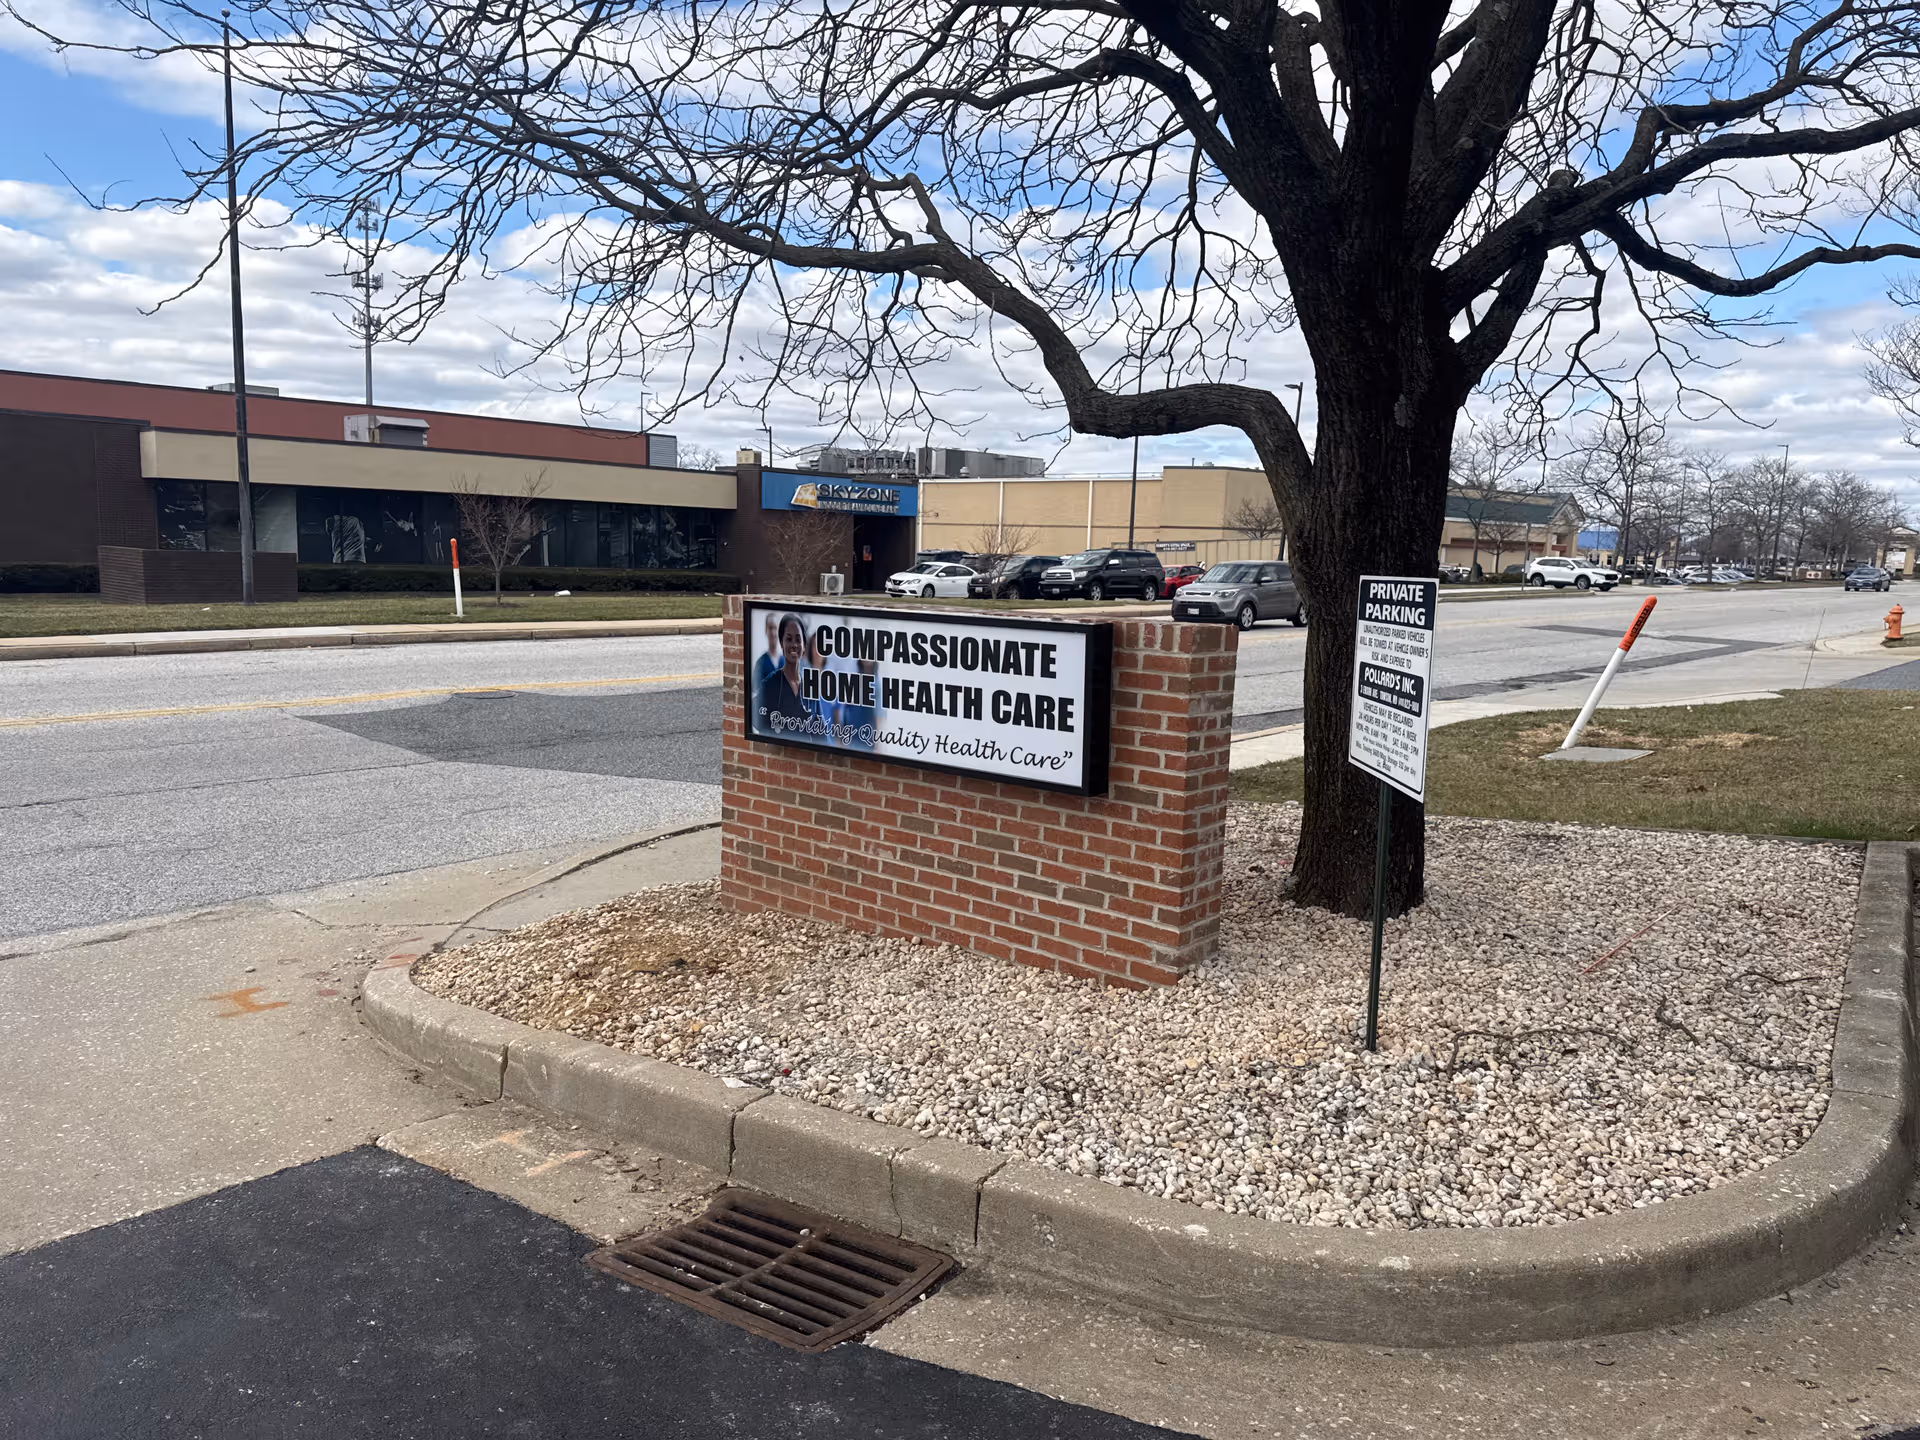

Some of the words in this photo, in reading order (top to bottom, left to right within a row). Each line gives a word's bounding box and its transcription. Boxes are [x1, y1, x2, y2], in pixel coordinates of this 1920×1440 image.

[818, 484, 852, 499] SKY
[855, 486, 900, 502] ZONE
[1369, 583, 1424, 602] PRIVATE
[1365, 603, 1426, 626] PARKING
[1363, 624, 1391, 637] UNAUTHORIZED
[1391, 628, 1406, 640] PARKED
[1407, 631, 1425, 643] VEHICLES
[816, 625, 1057, 679] COMPASSIONATE
[1368, 637, 1373, 647] BE
[1374, 638, 1387, 650] TOWED
[1387, 641, 1393, 651] AT
[1394, 642, 1409, 655] VEHICLE
[1409, 645, 1429, 659] OWNER'S
[1371, 651, 1379, 662] RISK
[1380, 653, 1388, 664] AND
[1389, 655, 1405, 668] EXPENSE
[1405, 659, 1412, 670] TO
[1364, 667, 1400, 691] POLLARD'S
[1401, 677, 1417, 696] INC.
[803, 668, 876, 708] HOME
[882, 677, 983, 721] HEALTH
[991, 689, 1075, 733] CARE
[1363, 713, 1374, 724] HOURS
[1407, 730, 1418, 743] WEEK
[1379, 707, 1387, 718] MAY
[1387, 710, 1392, 720] BE
[1393, 712, 1414, 728] RECLAIMED
[858, 723, 930, 755] Quality
[934, 734, 1007, 762] Health
